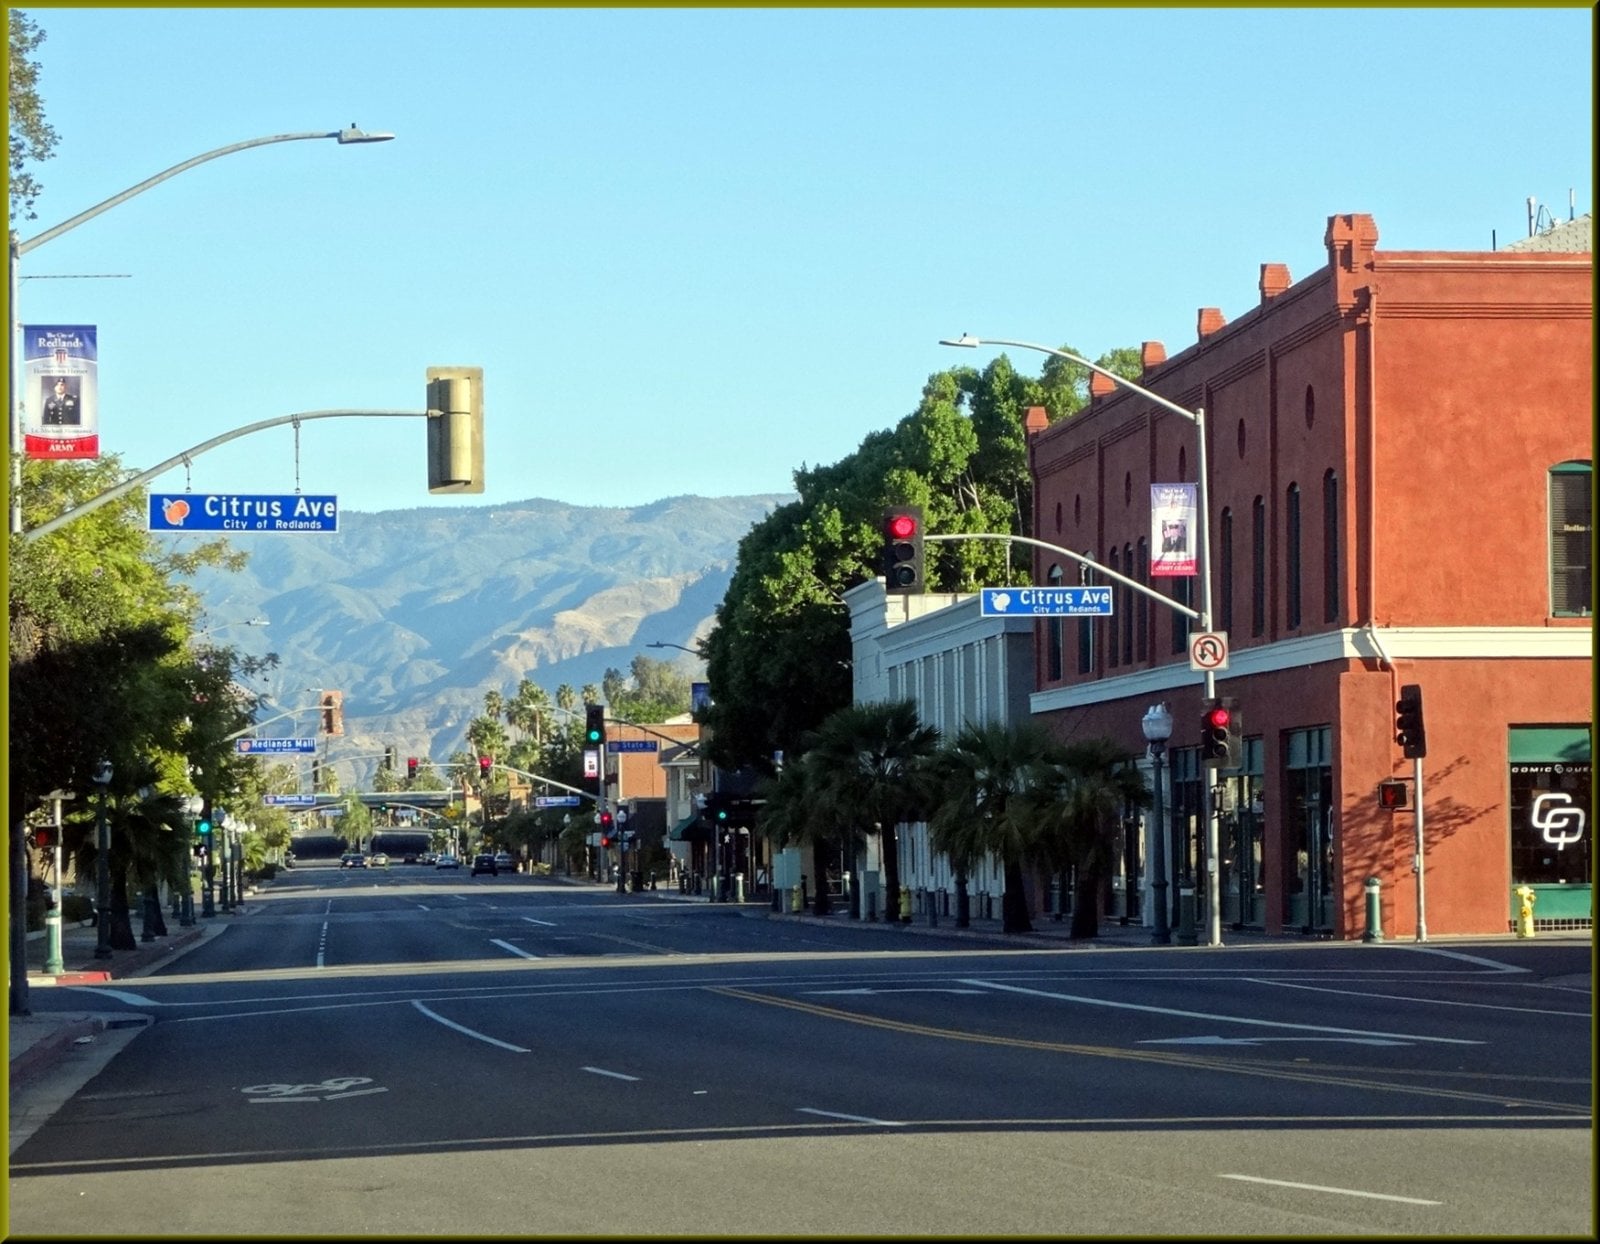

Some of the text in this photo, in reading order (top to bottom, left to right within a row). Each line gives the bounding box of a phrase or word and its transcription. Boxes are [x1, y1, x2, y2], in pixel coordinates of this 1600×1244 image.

[38, 337, 84, 348] Redlands
[49, 443, 75, 452] ARMY
[205, 496, 336, 517] Citrus Ave
[223, 519, 322, 530] City of Redlands
[1020, 590, 1110, 605] Citrus Ave
[1033, 605, 1101, 613] City of Redlands
[252, 739, 314, 748] Redlands Mall
[621, 741, 644, 749] State
